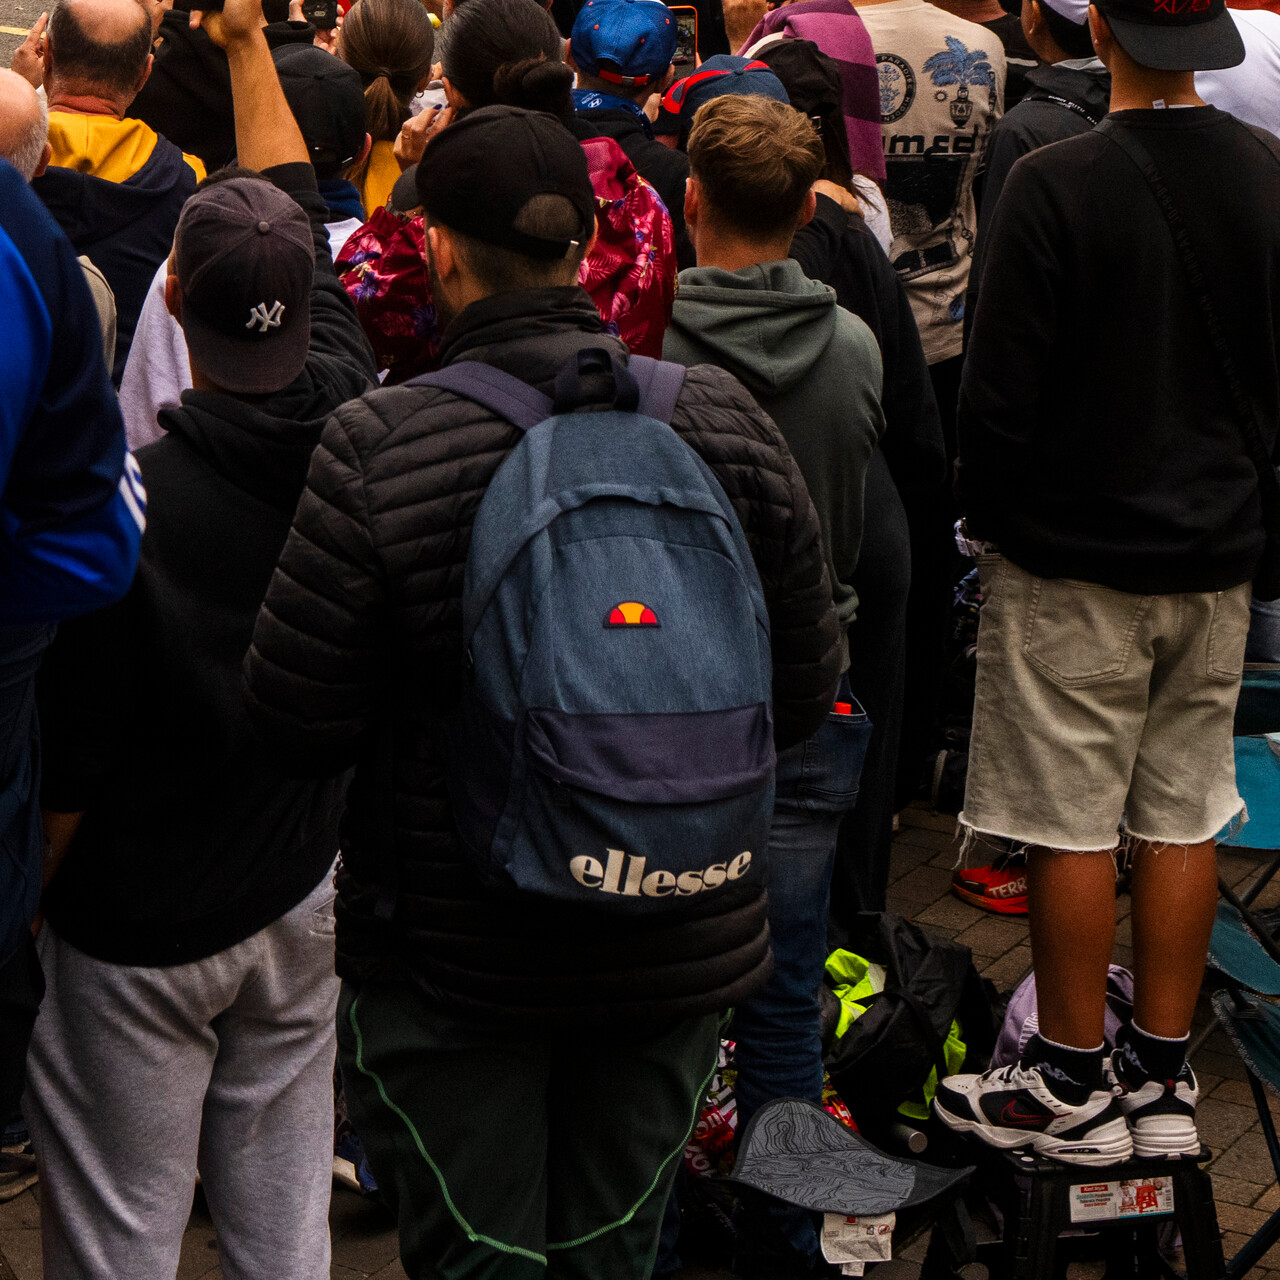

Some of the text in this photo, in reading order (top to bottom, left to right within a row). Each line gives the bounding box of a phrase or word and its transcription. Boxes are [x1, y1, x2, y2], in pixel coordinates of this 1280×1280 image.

[245, 299, 286, 333] NY
[569, 847, 753, 898] ellesse
[988, 876, 1028, 900] TERR
